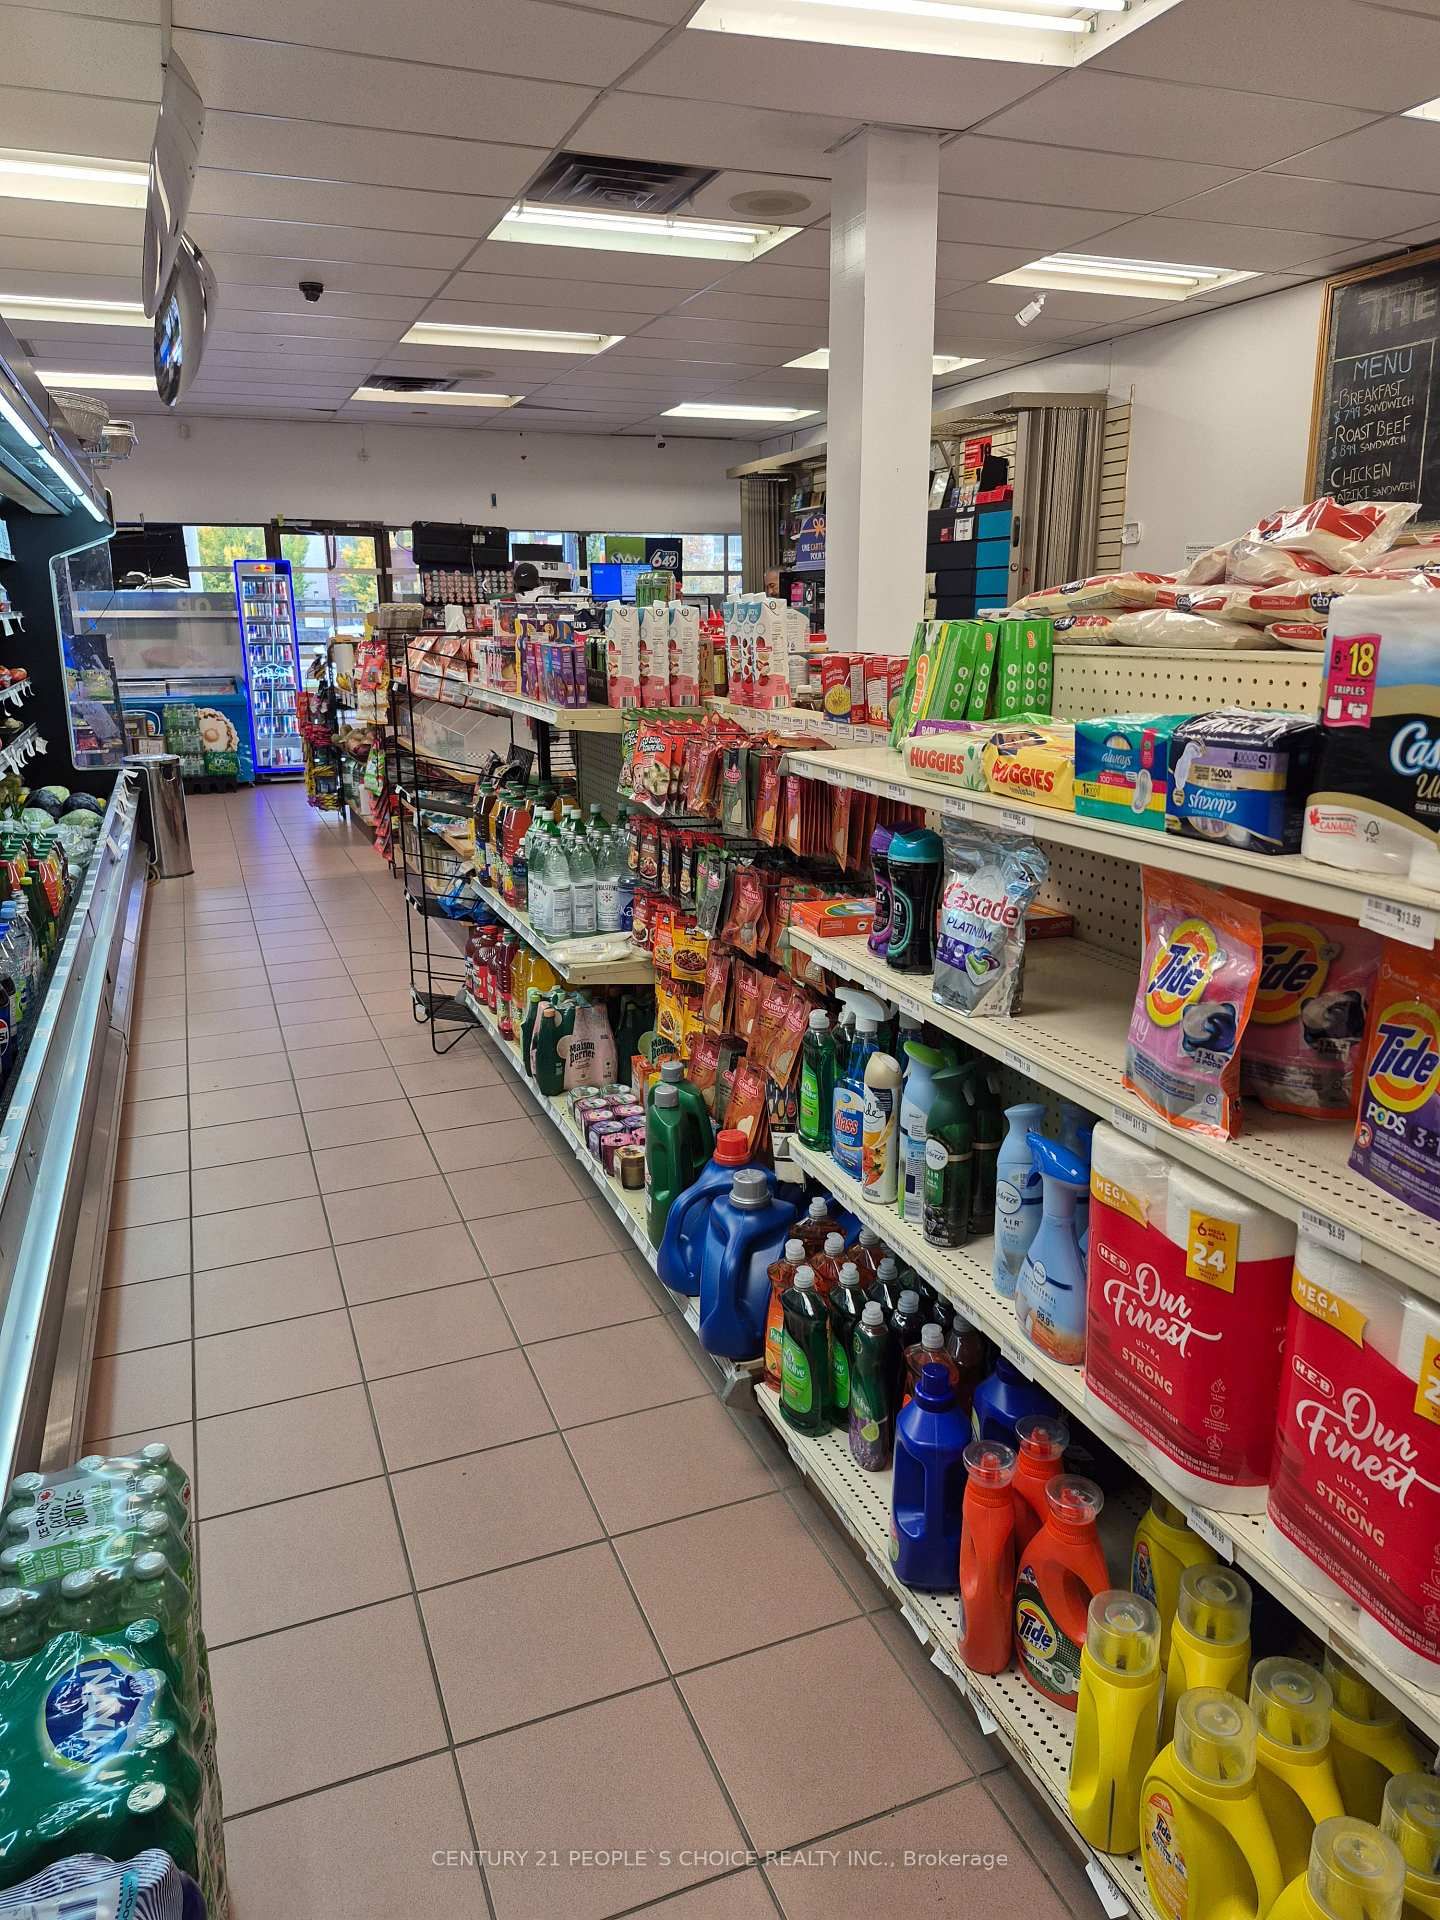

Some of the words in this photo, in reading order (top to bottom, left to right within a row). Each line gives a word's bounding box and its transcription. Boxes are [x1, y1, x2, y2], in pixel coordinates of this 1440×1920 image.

[1353, 347, 1413, 382] MENU
[1363, 394, 1415, 417] SANDWICH
[1377, 415, 1412, 437] BEEF
[1360, 434, 1406, 453] SANDWICH
[1372, 480, 1416, 498] SANDWICH
[1350, 642, 1375, 677] 18
[1333, 684, 1366, 696] TRIPLES
[910, 746, 965, 776] HUGGIES
[1101, 748, 1132, 769] always
[1390, 720, 1440, 776] Cas
[991, 757, 1056, 793] HUGGIES
[1210, 767, 1232, 780] 100%
[1416, 773, 1440, 799] Ul
[1188, 789, 1237, 818] always
[1428, 803, 1440, 812] SOF
[943, 882, 1021, 928] Cascade
[946, 917, 993, 942] PLATINUM
[1146, 943, 1206, 998] Tide
[569, 1041, 595, 1055] Maison
[1369, 1022, 1440, 1087] Tide
[835, 1110, 859, 1136] Glass
[1366, 1101, 1407, 1137] PODS
[1095, 1177, 1130, 1205] MEGA
[1197, 1221, 1207, 1237] 6
[1193, 1241, 1227, 1273] 24
[1135, 1262, 1192, 1320] Our
[1297, 1282, 1341, 1318] MEGA
[1103, 1278, 1223, 1360] Finest
[1135, 1337, 1161, 1363] ULTRA
[1121, 1347, 1174, 1397] STRONG
[1341, 1387, 1420, 1462] Our
[1295, 1398, 1440, 1508] Finest
[1336, 1473, 1370, 1505] ULTRA
[1315, 1480, 1386, 1548] STRONG
[1304, 1503, 1323, 1525] SUPER
[1323, 1520, 1352, 1548] PREMIUM
[1351, 1544, 1368, 1564] BATH
[1019, 1608, 1053, 1649] Tide
